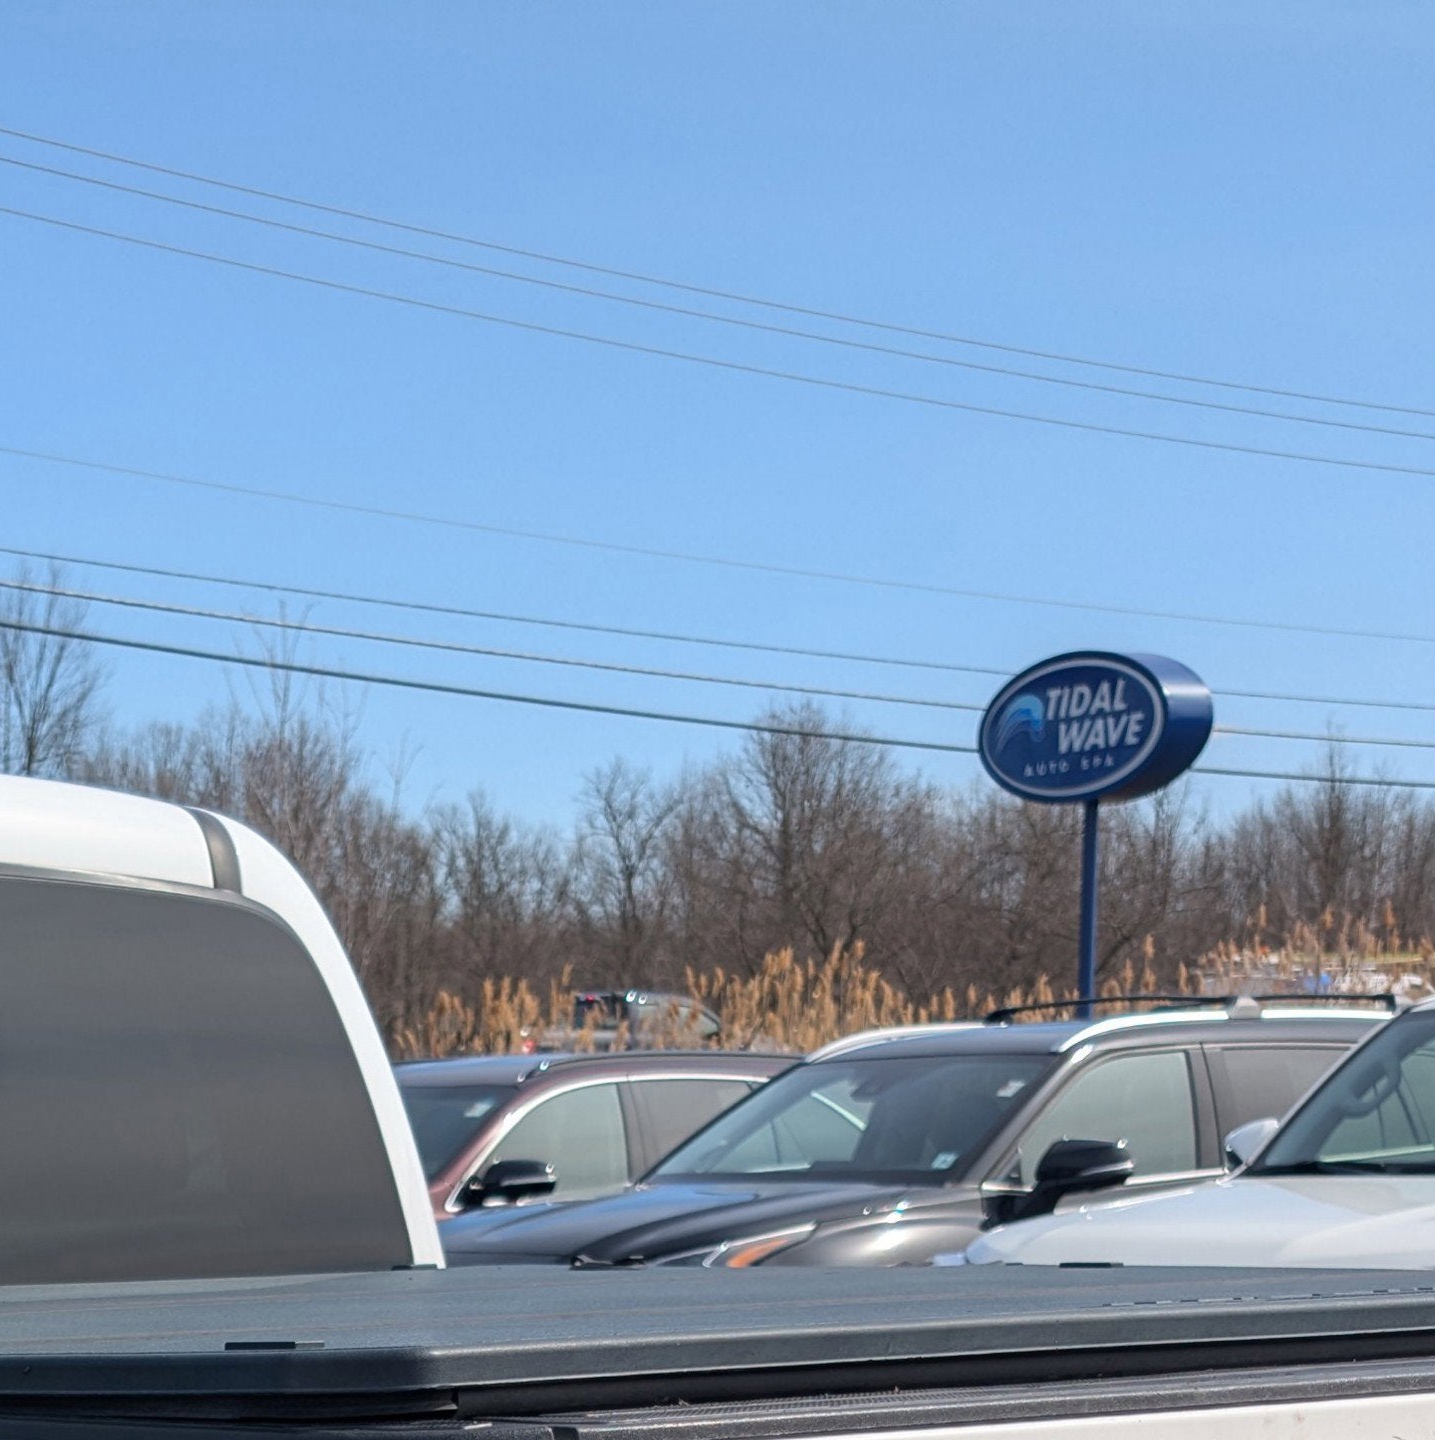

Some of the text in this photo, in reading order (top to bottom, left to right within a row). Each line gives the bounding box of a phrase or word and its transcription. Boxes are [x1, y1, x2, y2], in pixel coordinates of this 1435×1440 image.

[1045, 676, 1129, 721] TIDAL
[1058, 711, 1145, 755] WAVE
[1023, 754, 1115, 778] AUTO SPA
